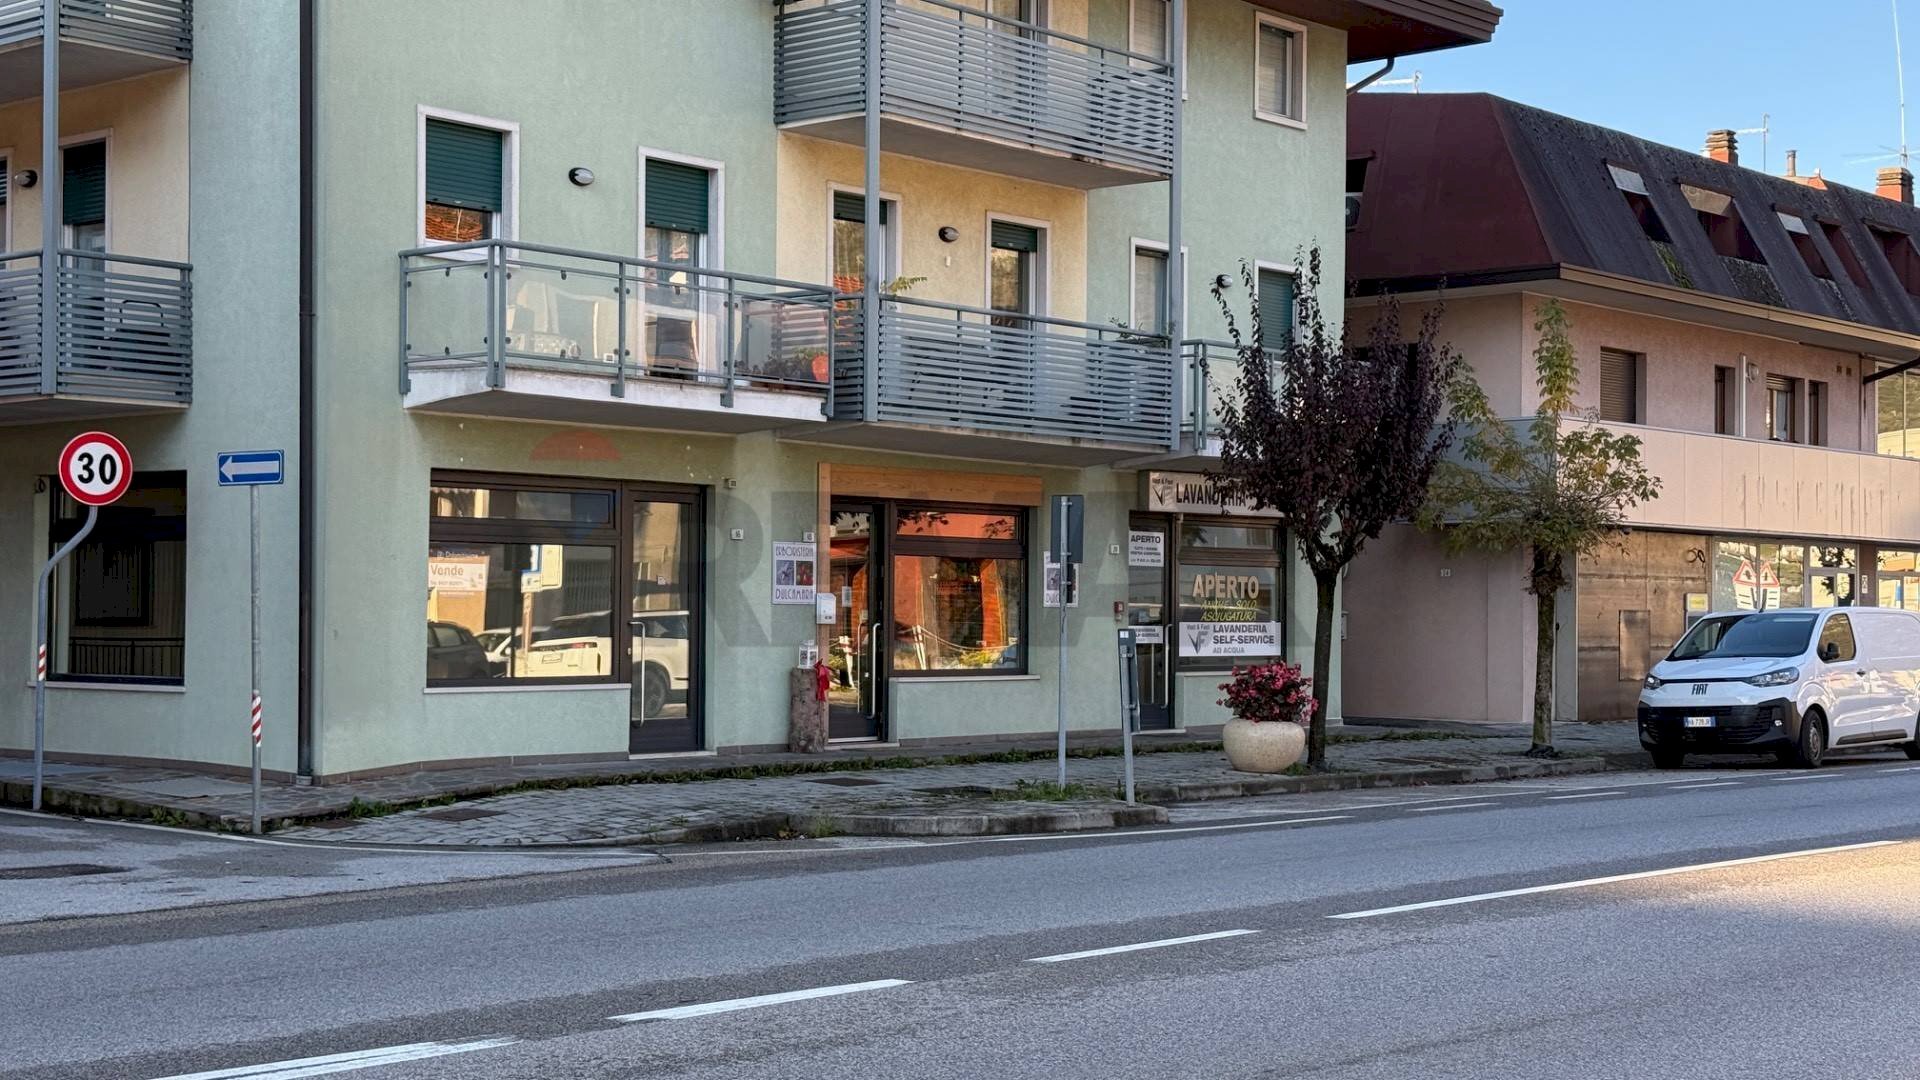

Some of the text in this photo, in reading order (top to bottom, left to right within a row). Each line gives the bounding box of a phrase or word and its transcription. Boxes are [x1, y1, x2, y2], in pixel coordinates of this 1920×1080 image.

[77, 452, 117, 485] 30
[1130, 534, 1161, 544] APERTO
[1192, 574, 1260, 599] APERTO
[1235, 599, 1257, 609] SOLO
[1200, 610, 1257, 622] ASCIUGATURA
[1212, 624, 1267, 634] LAVANDERIA
[1212, 634, 1275, 645] SELF-SERVICE
[1223, 647, 1246, 655] ACQUA
[1691, 683, 1709, 696] FIAT
